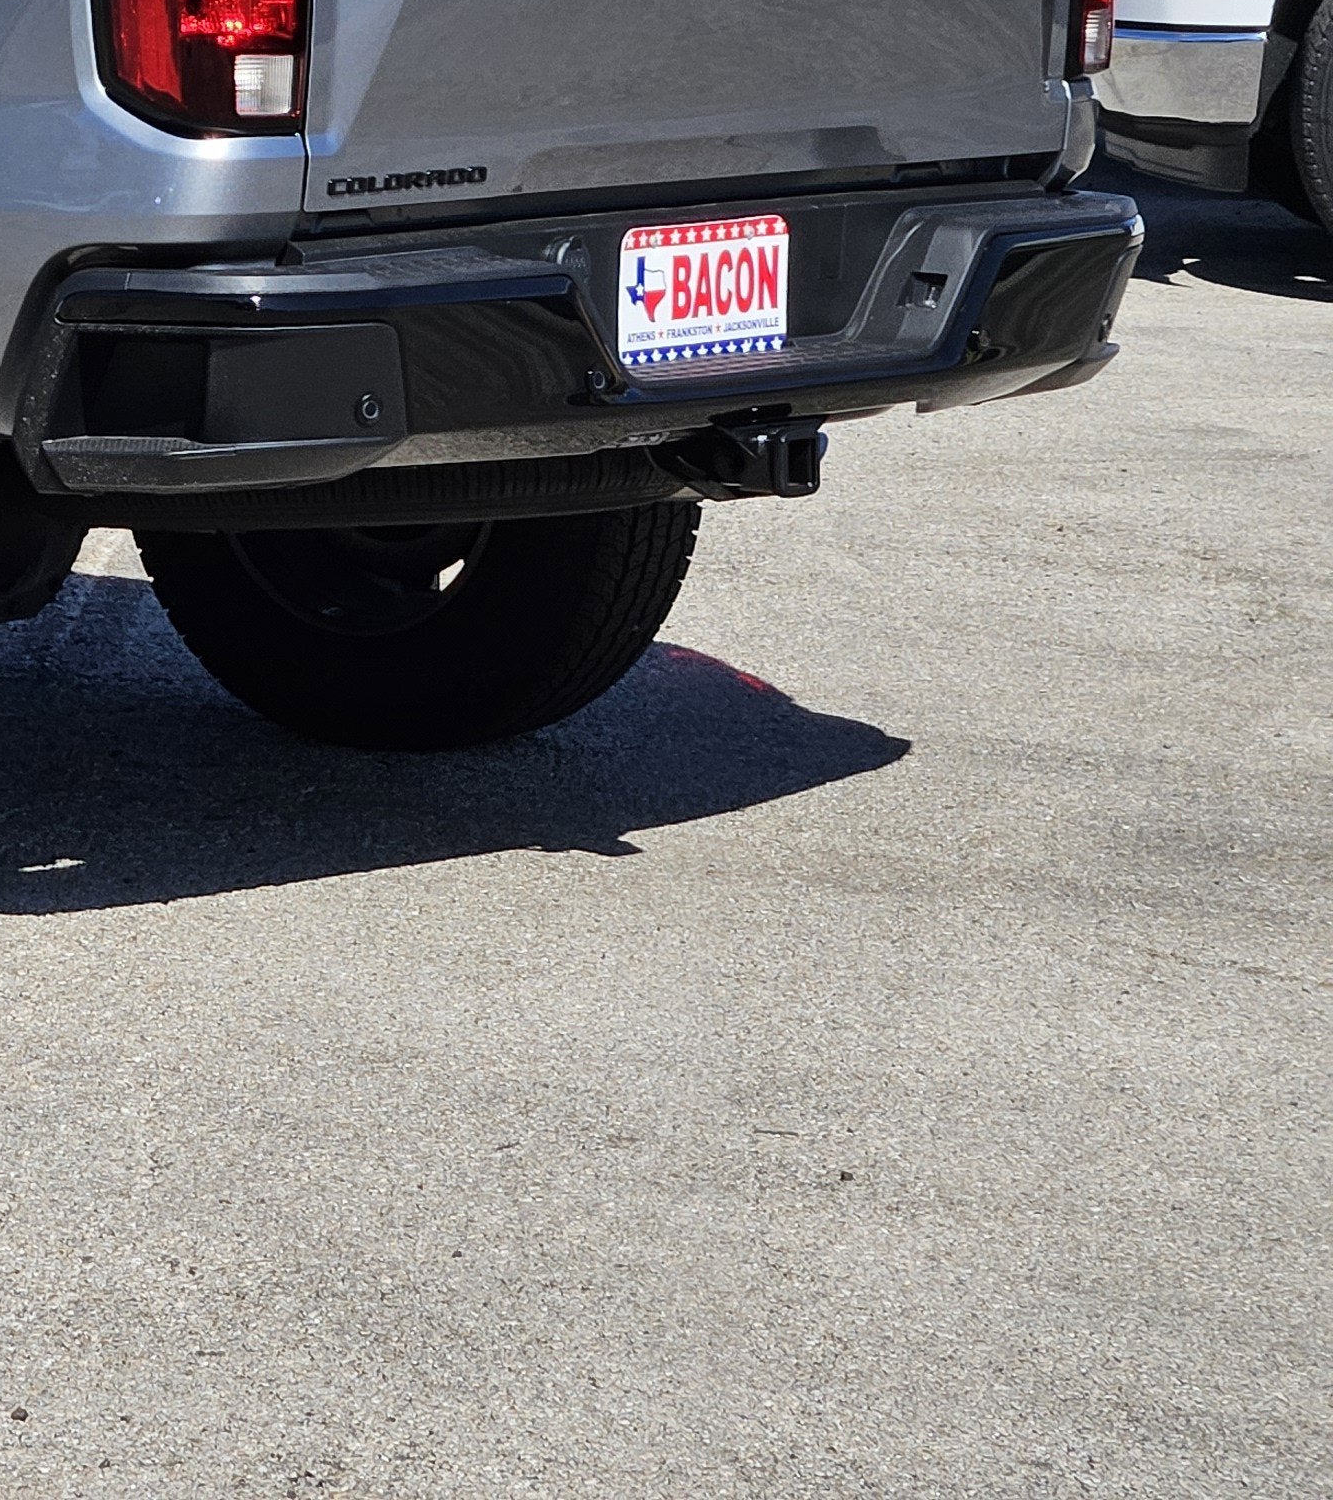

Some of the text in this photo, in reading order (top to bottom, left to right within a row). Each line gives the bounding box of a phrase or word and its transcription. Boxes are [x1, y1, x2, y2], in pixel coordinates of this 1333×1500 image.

[327, 166, 487, 195] COLORADO
[671, 245, 780, 320] BACON
[627, 317, 779, 343] ATHENS FRANKSTON JACKSONVILLE
